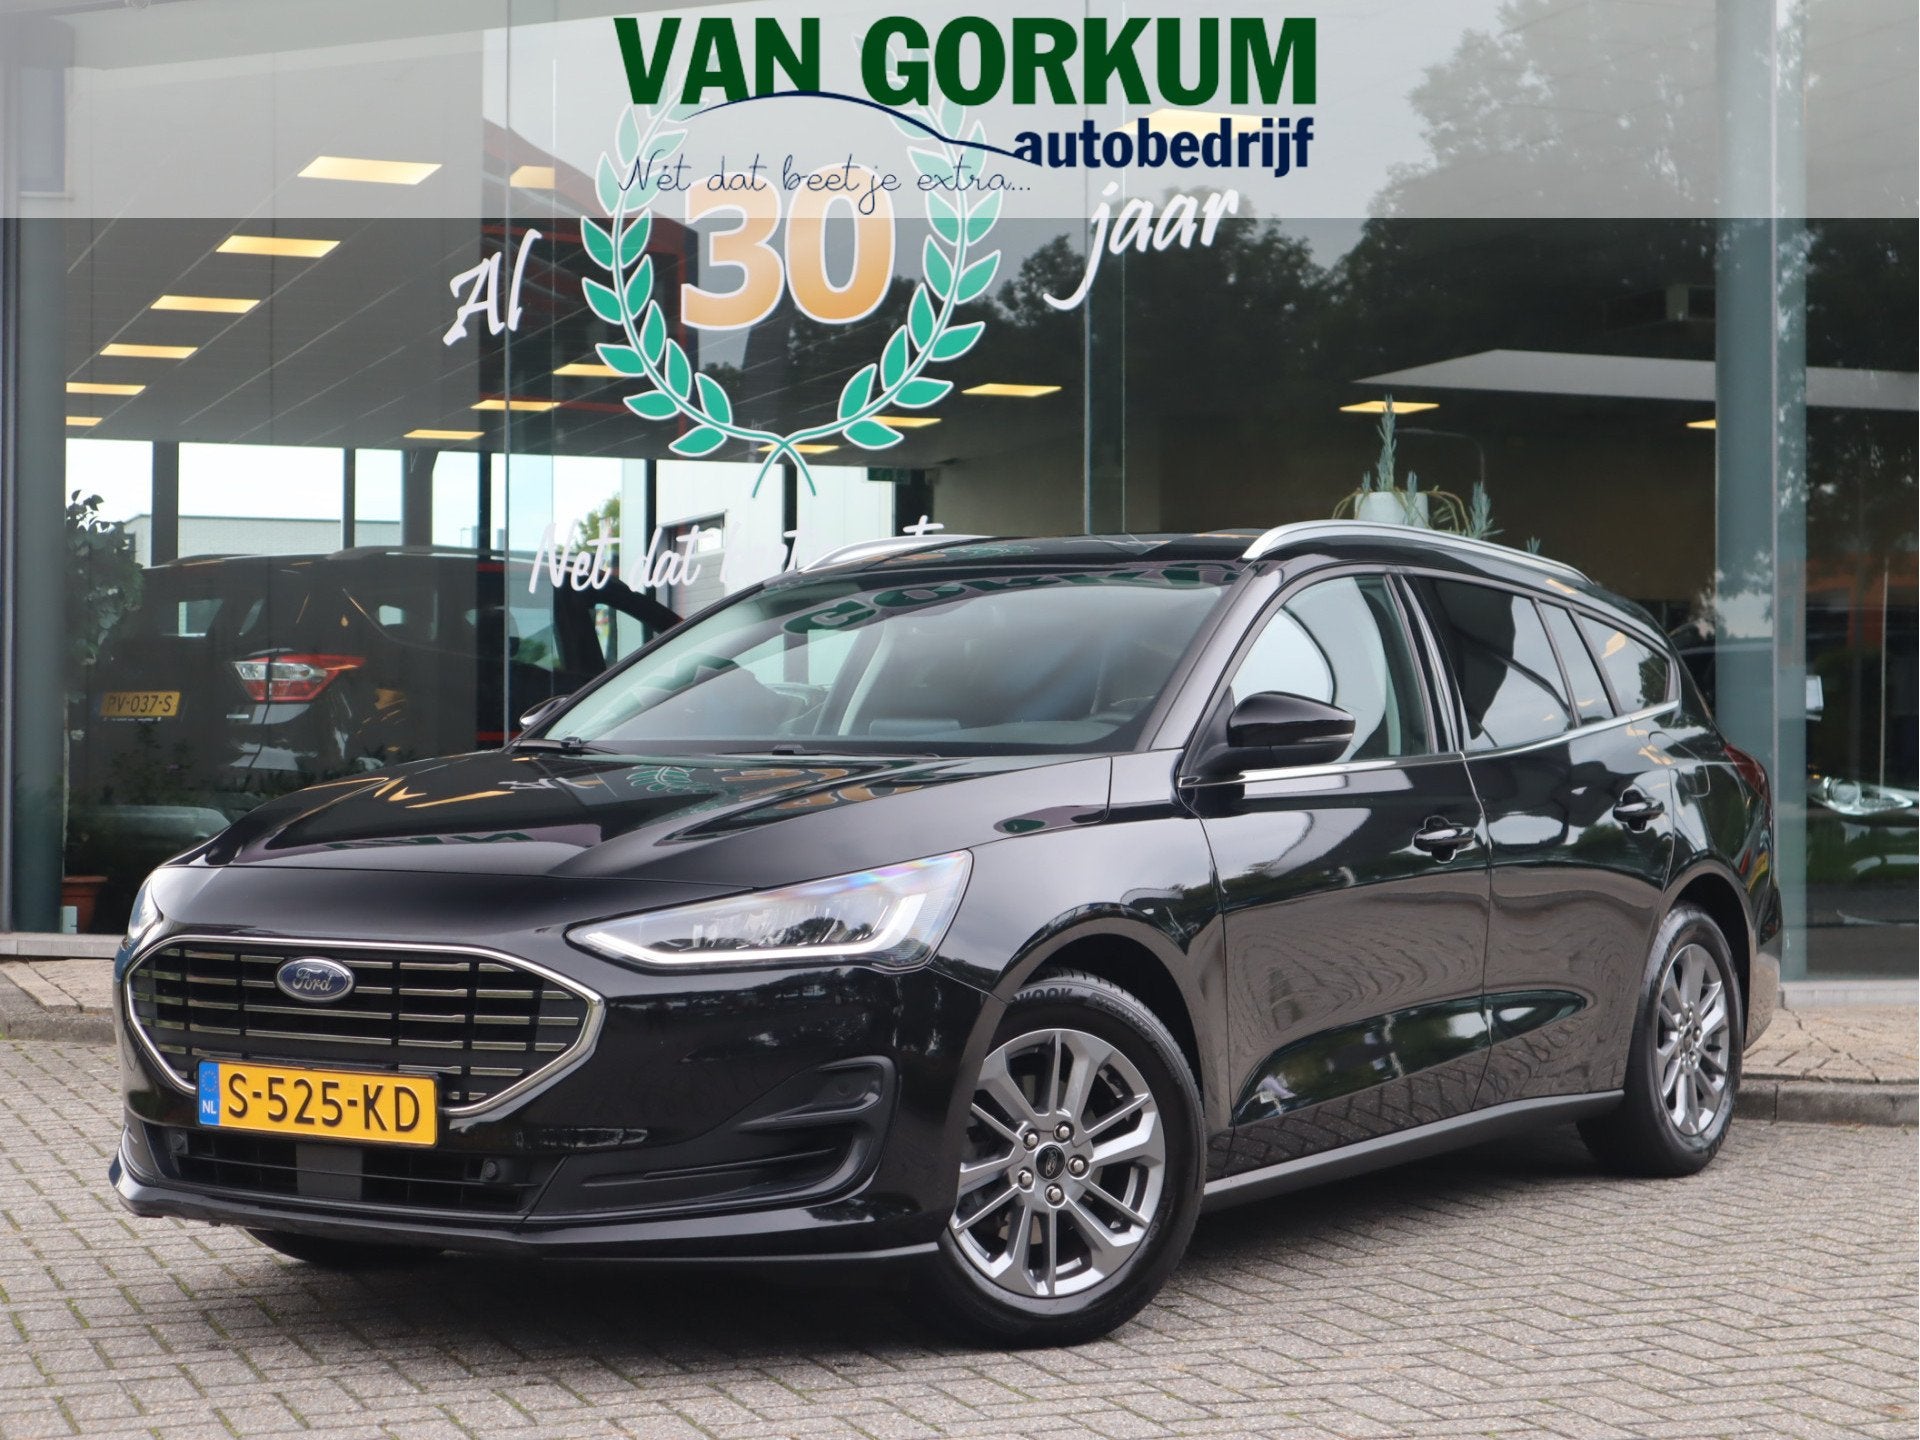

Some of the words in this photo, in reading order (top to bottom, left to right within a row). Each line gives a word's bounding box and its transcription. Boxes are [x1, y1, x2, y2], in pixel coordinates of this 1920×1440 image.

[443, 228, 542, 346] Al
[681, 163, 895, 331] 30
[1042, 181, 1240, 311] jaar
[529, 521, 622, 594] Net
[628, 524, 713, 592] dat
[105, 694, 174, 714] PV-037-S
[292, 967, 333, 992] Ford
[202, 1100, 217, 1115] NL
[228, 1072, 421, 1133] S-525-KD
